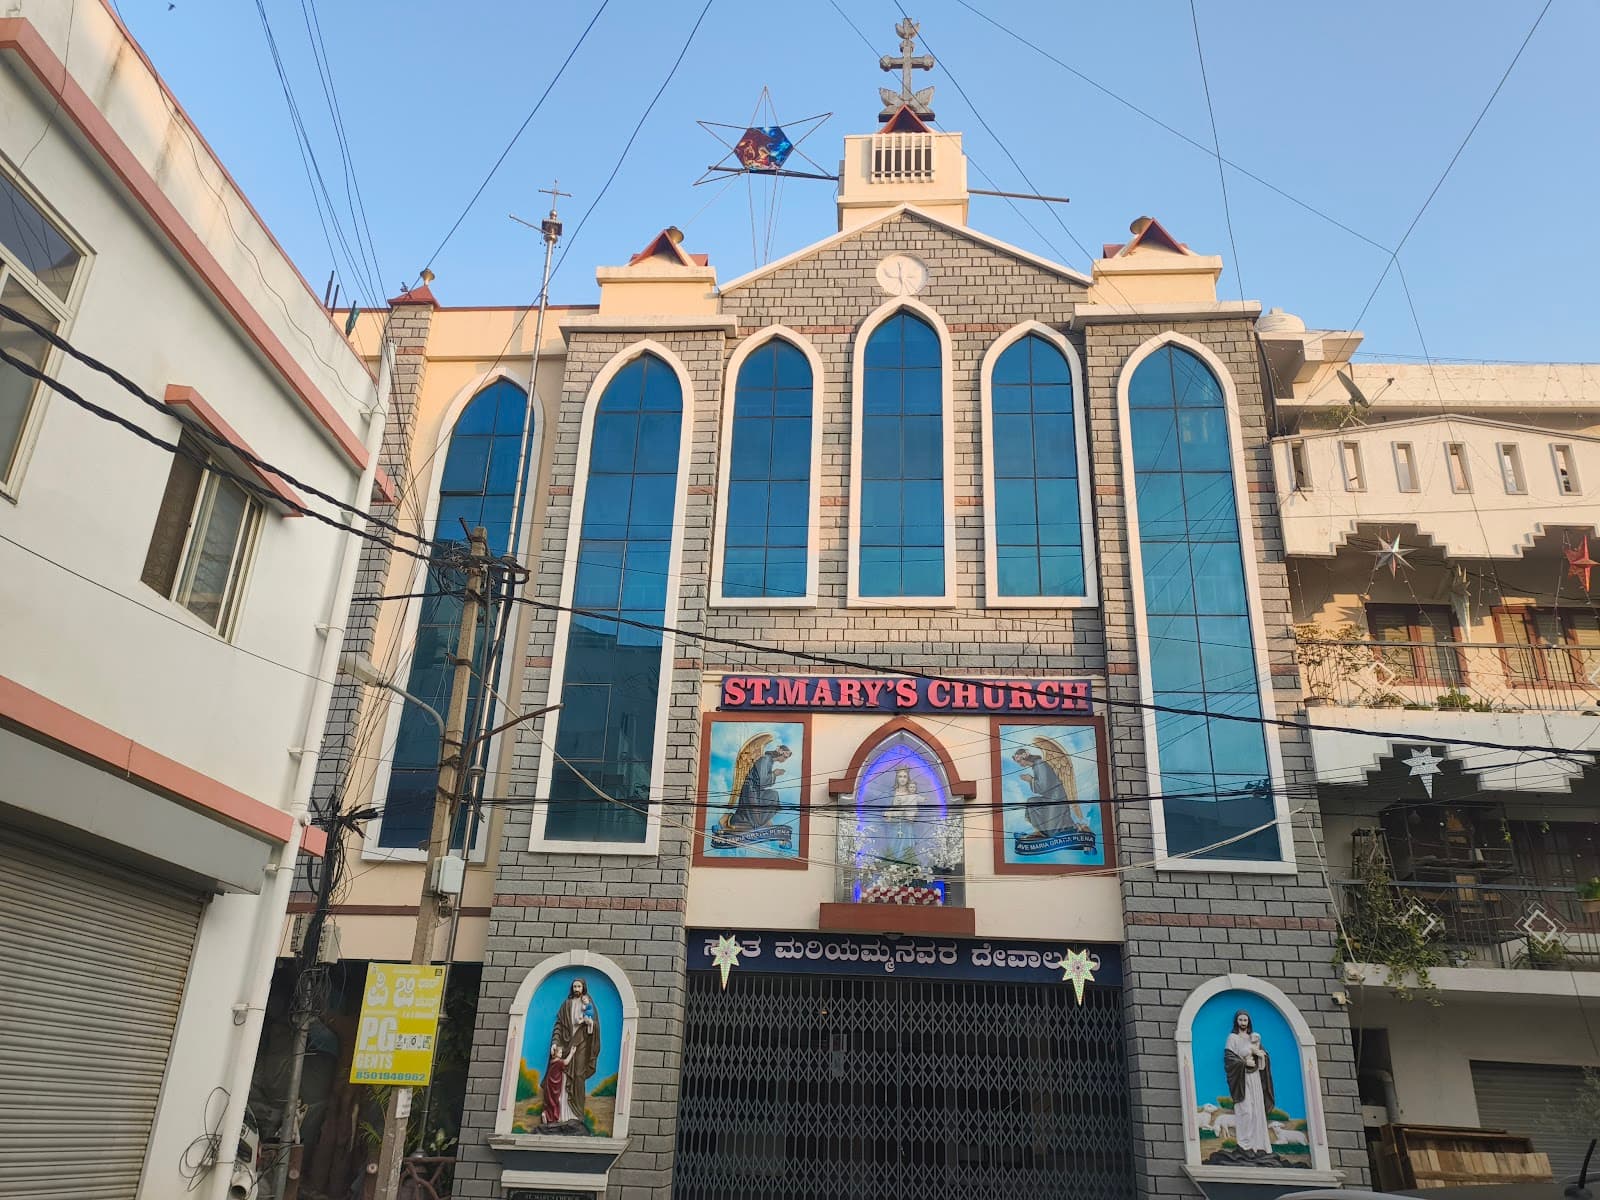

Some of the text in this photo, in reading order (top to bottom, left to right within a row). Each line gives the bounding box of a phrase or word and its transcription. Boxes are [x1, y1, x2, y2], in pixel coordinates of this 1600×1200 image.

[724, 677, 1089, 711] ST.MARY'S CHURCH
[1030, 841, 1050, 850] MARIA
[1049, 836, 1072, 845] GRATIA
[1072, 834, 1094, 843] PLENA
[774, 936, 958, 973] ಮರಿಯಮ್ಮನವರ
[359, 1016, 398, 1052] PG
[355, 1054, 393, 1070] GENTS
